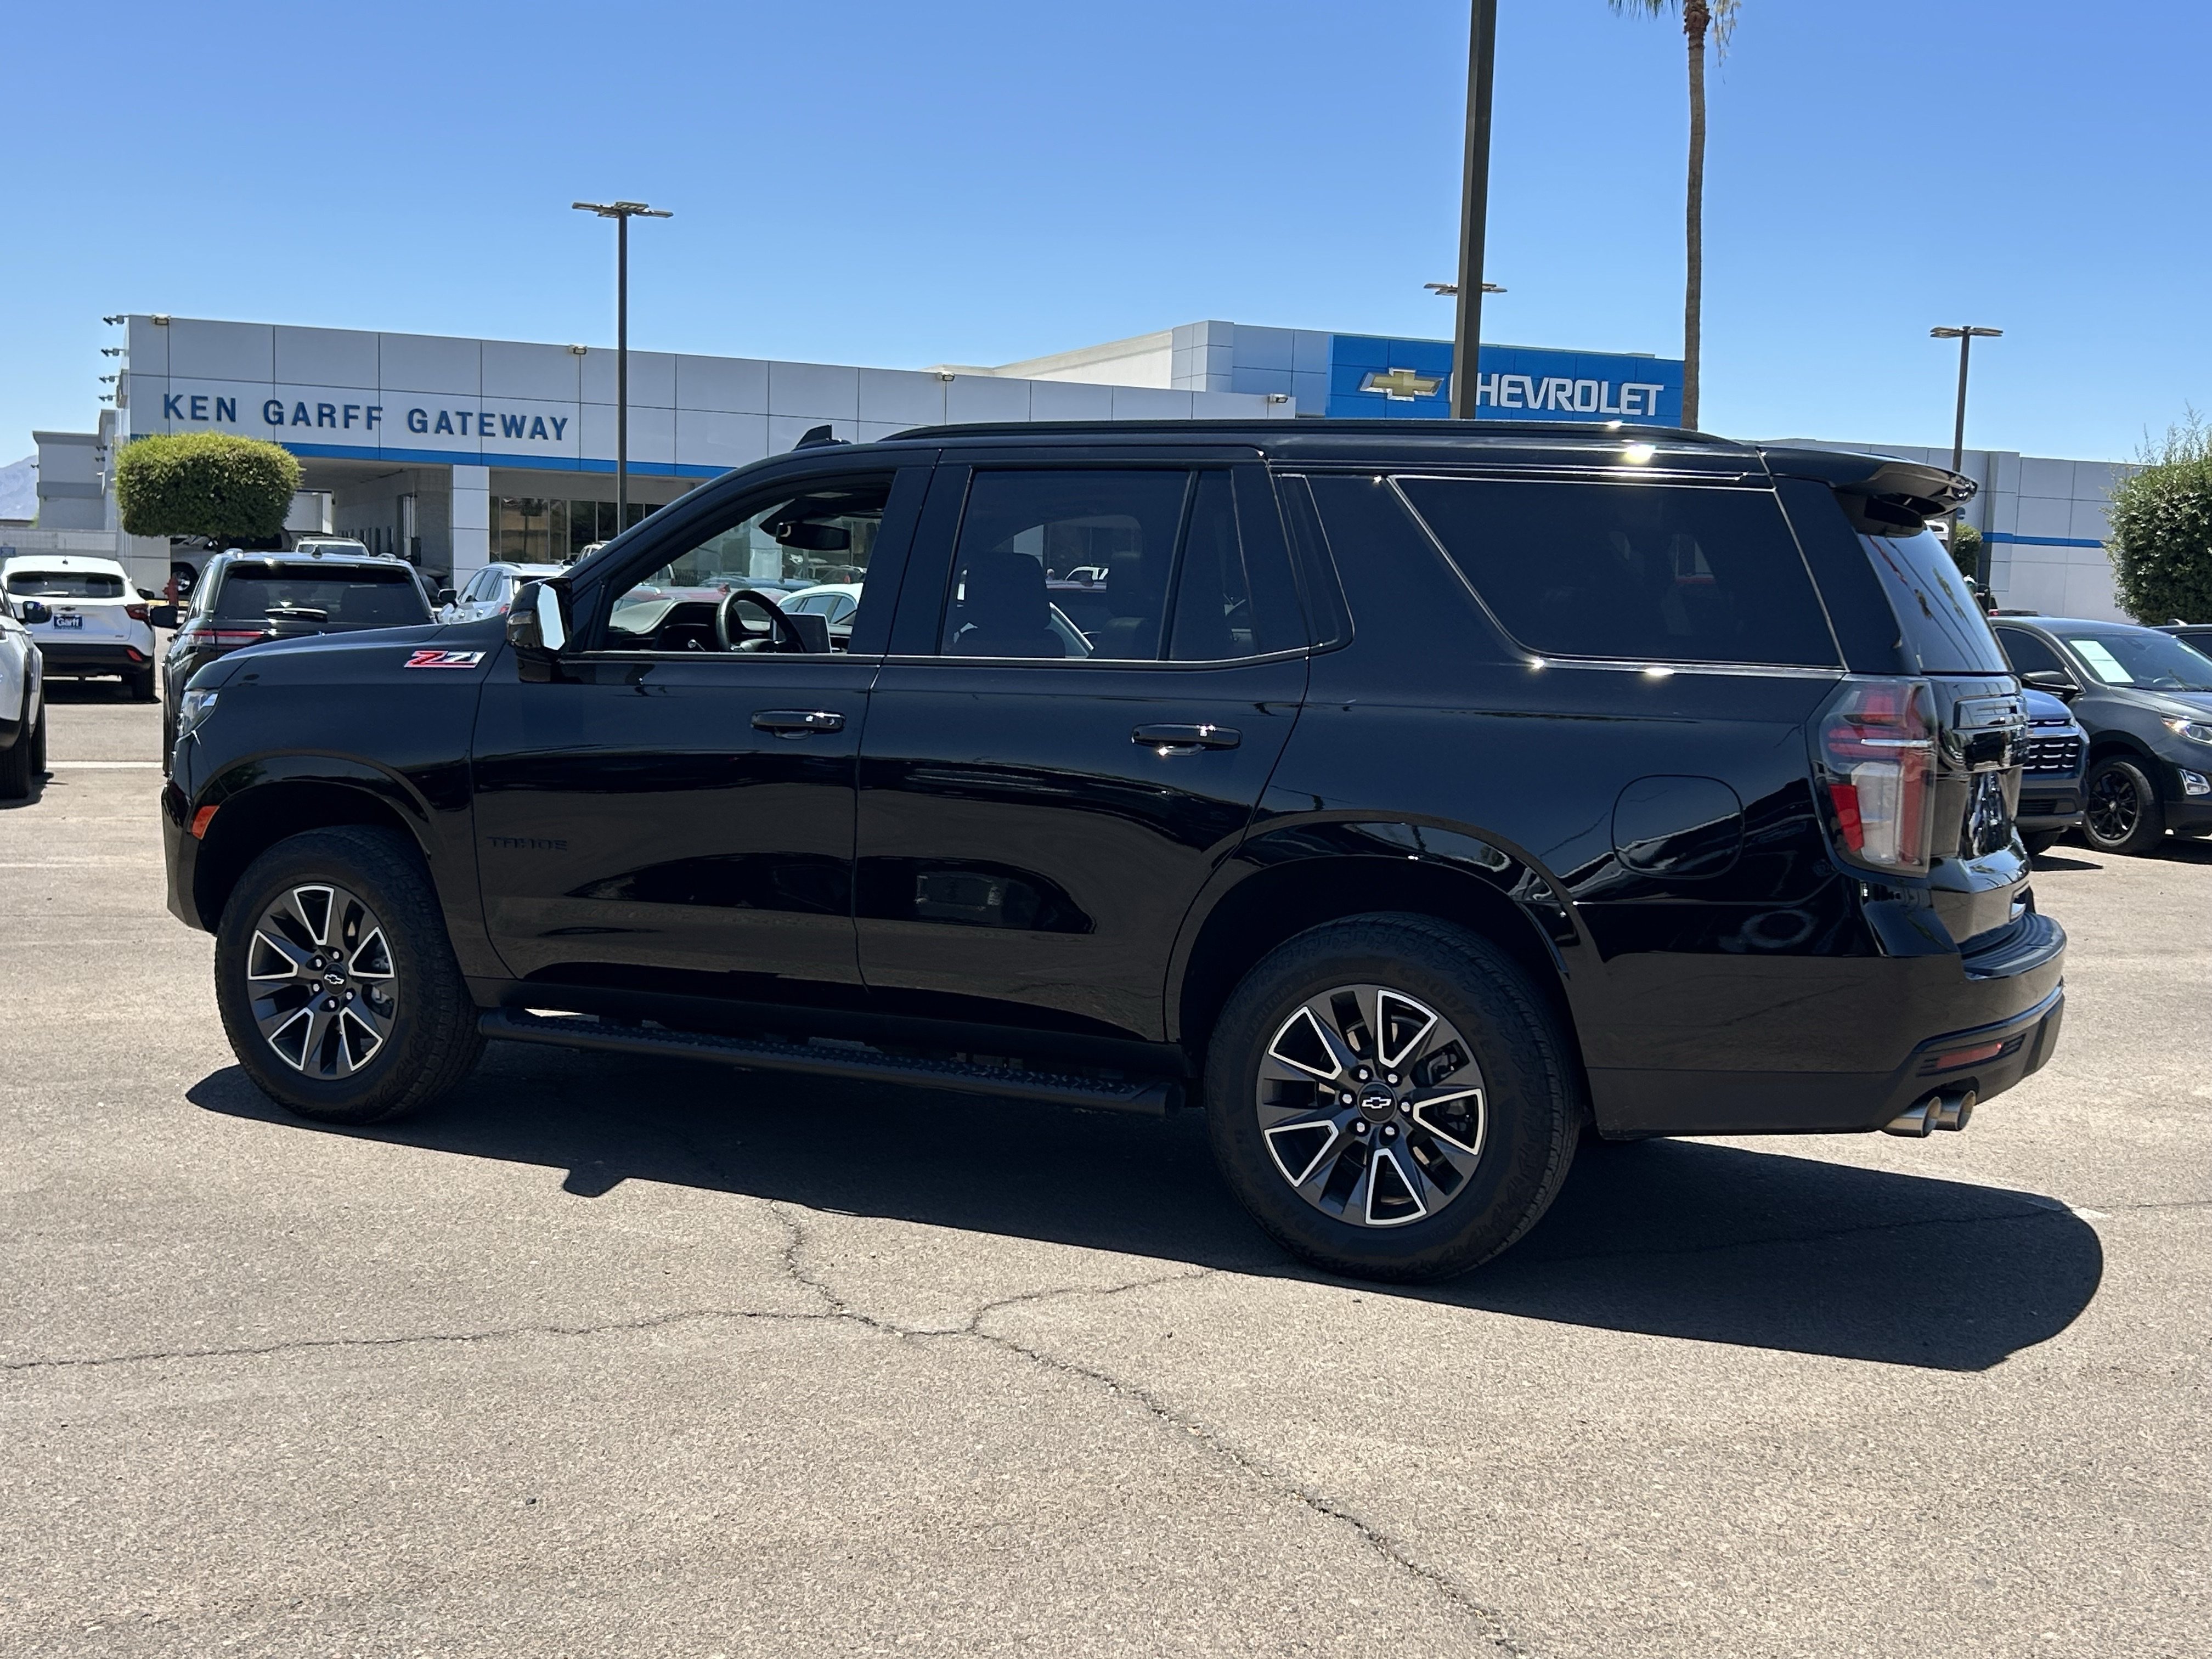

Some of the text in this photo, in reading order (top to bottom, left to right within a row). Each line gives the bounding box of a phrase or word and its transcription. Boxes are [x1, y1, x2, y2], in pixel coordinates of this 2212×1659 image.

[1449, 371, 1664, 416] HEVROLET
[163, 394, 568, 441] KEN GARFF GATEWAY
[404, 650, 487, 668] Z71
[486, 836, 568, 851] TAHOE
